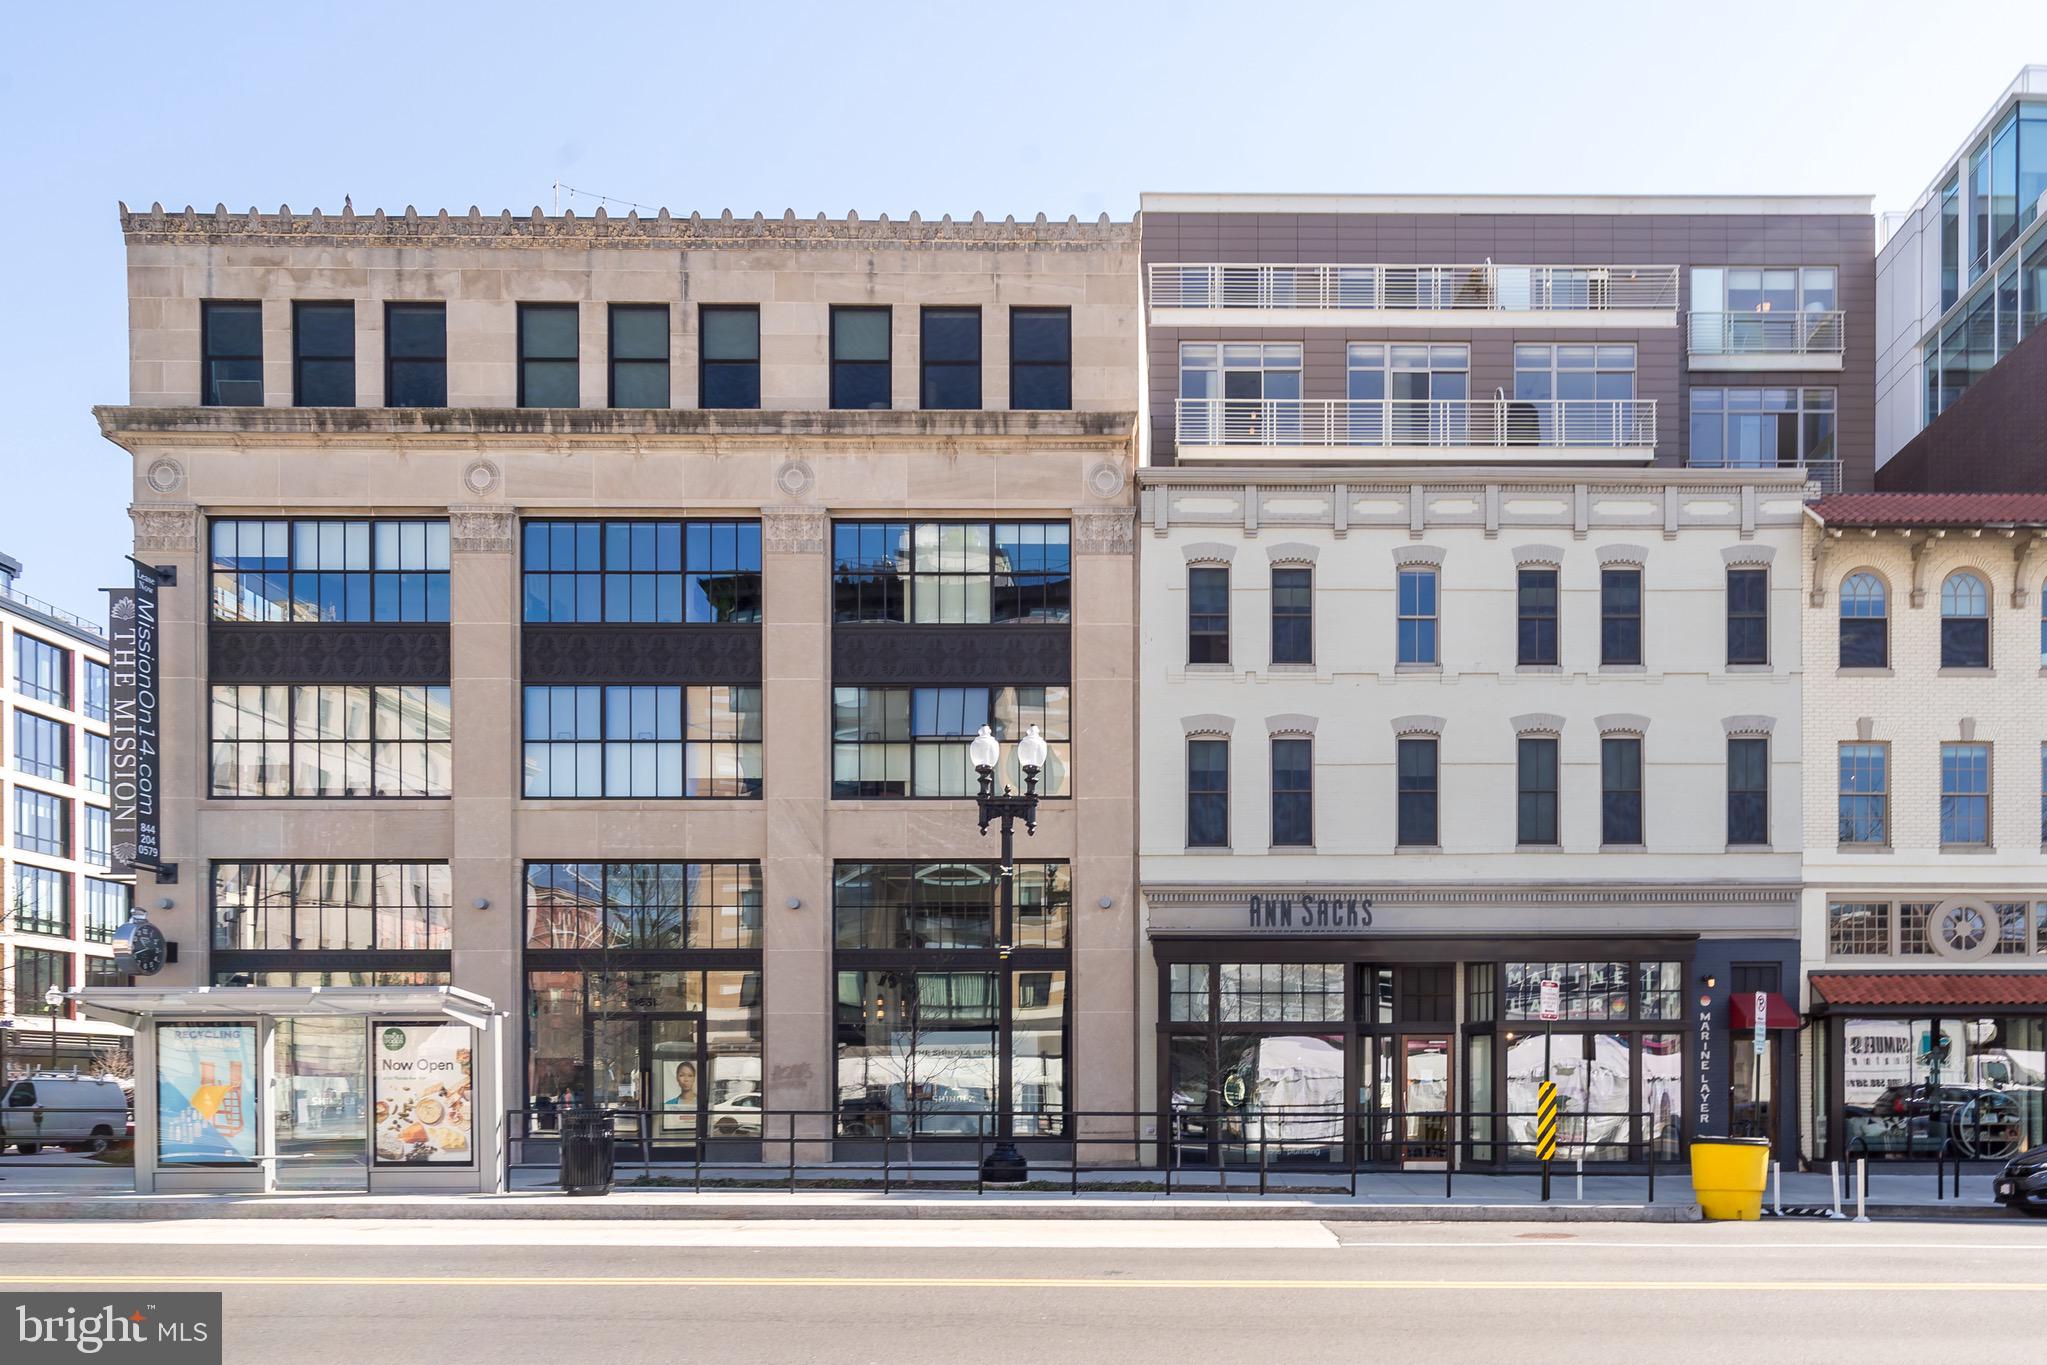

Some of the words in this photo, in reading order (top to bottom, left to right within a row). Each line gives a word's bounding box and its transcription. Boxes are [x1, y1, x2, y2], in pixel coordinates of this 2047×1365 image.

[114, 628, 136, 687] THE
[138, 597, 156, 815] MissionOn14.com
[114, 699, 137, 820] MISSION
[140, 822, 156, 834] 844
[140, 834, 156, 846] 204
[138, 845, 158, 857] 0579
[1249, 895, 1292, 927] ANN
[1302, 895, 1373, 927] SACKS
[1507, 970, 1625, 984] MARINE
[1509, 999, 1604, 1012] LAER
[175, 1030, 241, 1039] RECYCLING
[1700, 1012, 1711, 1070] MARINE
[382, 1059, 413, 1071] Now
[417, 1058, 454, 1073] Open
[1700, 1074, 1711, 1123] LAYER
